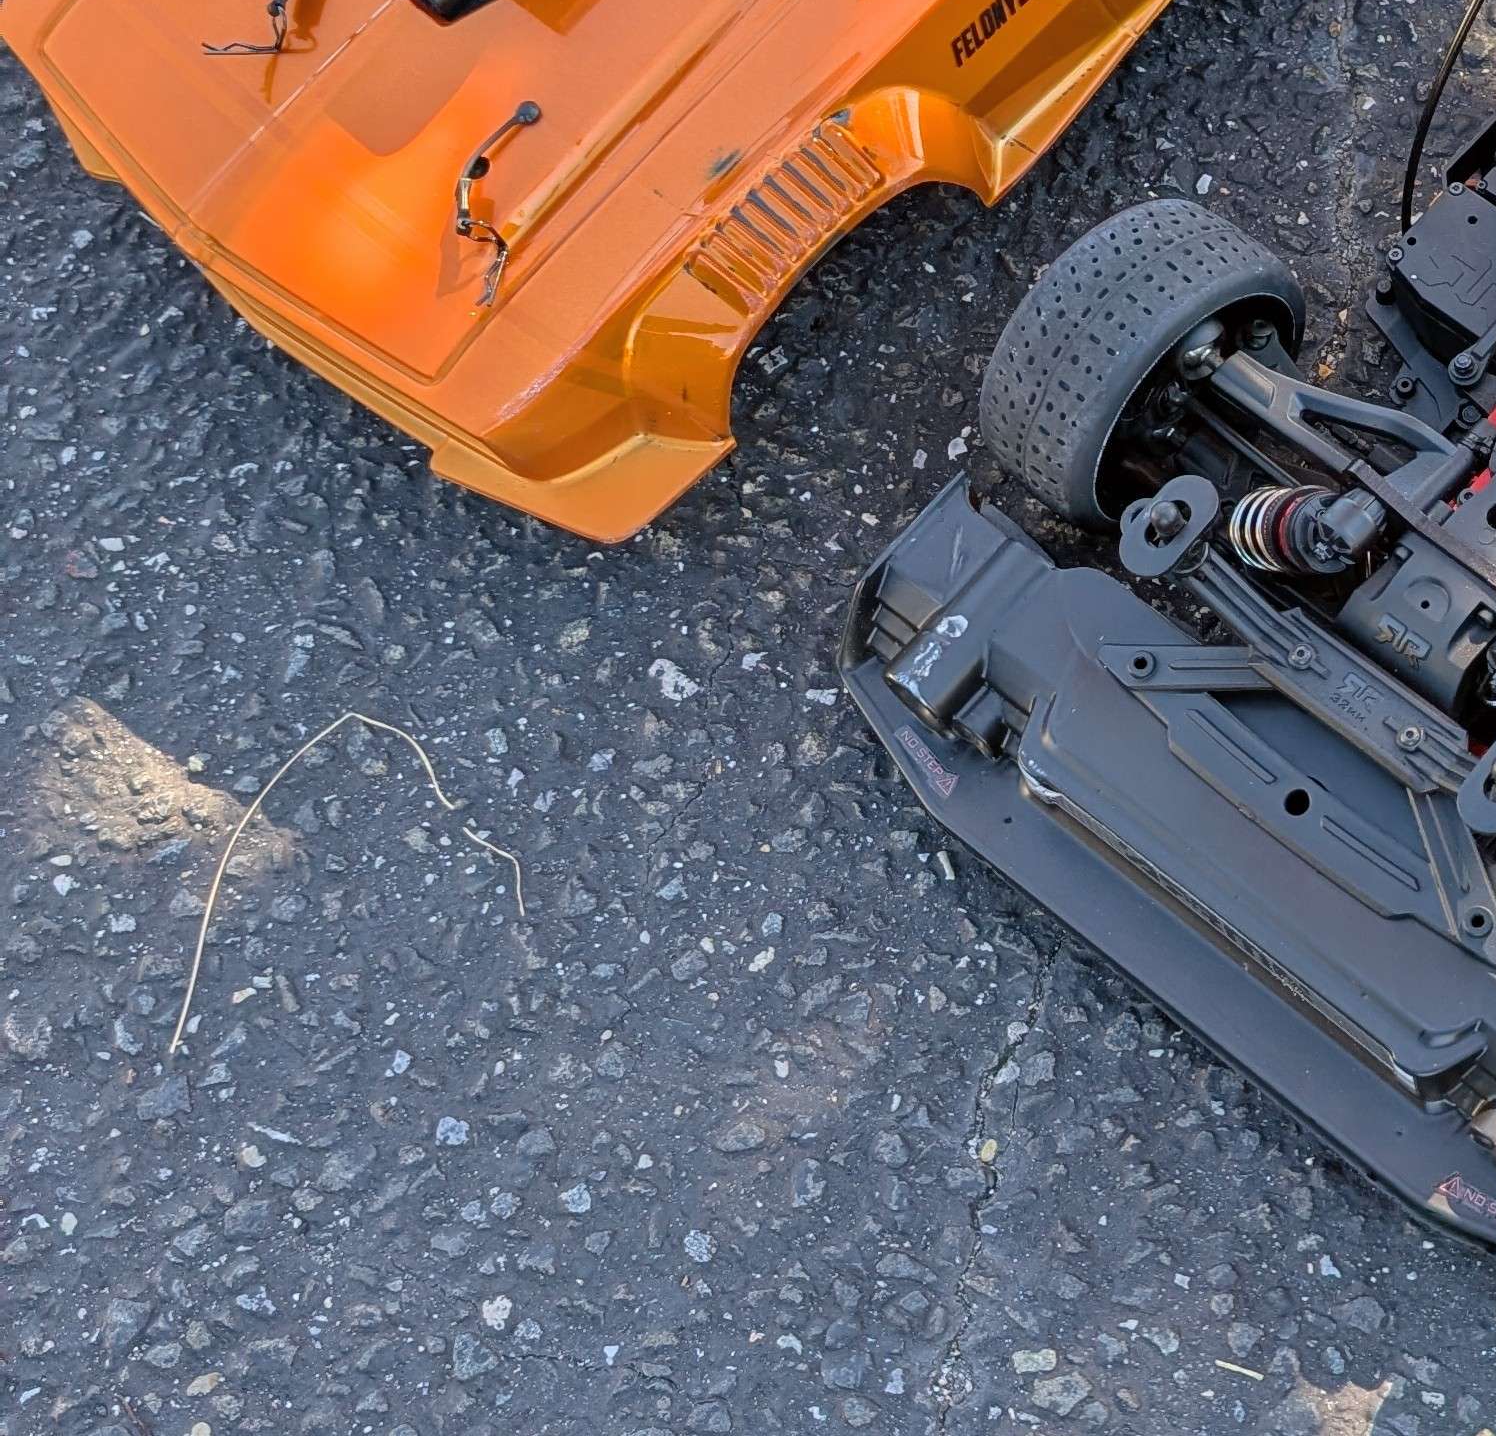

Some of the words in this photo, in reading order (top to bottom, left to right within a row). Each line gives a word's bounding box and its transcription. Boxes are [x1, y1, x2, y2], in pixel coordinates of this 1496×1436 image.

[899, 729, 919, 749] NO
[915, 746, 945, 778] STEP
[1462, 1187, 1487, 1207] NO
